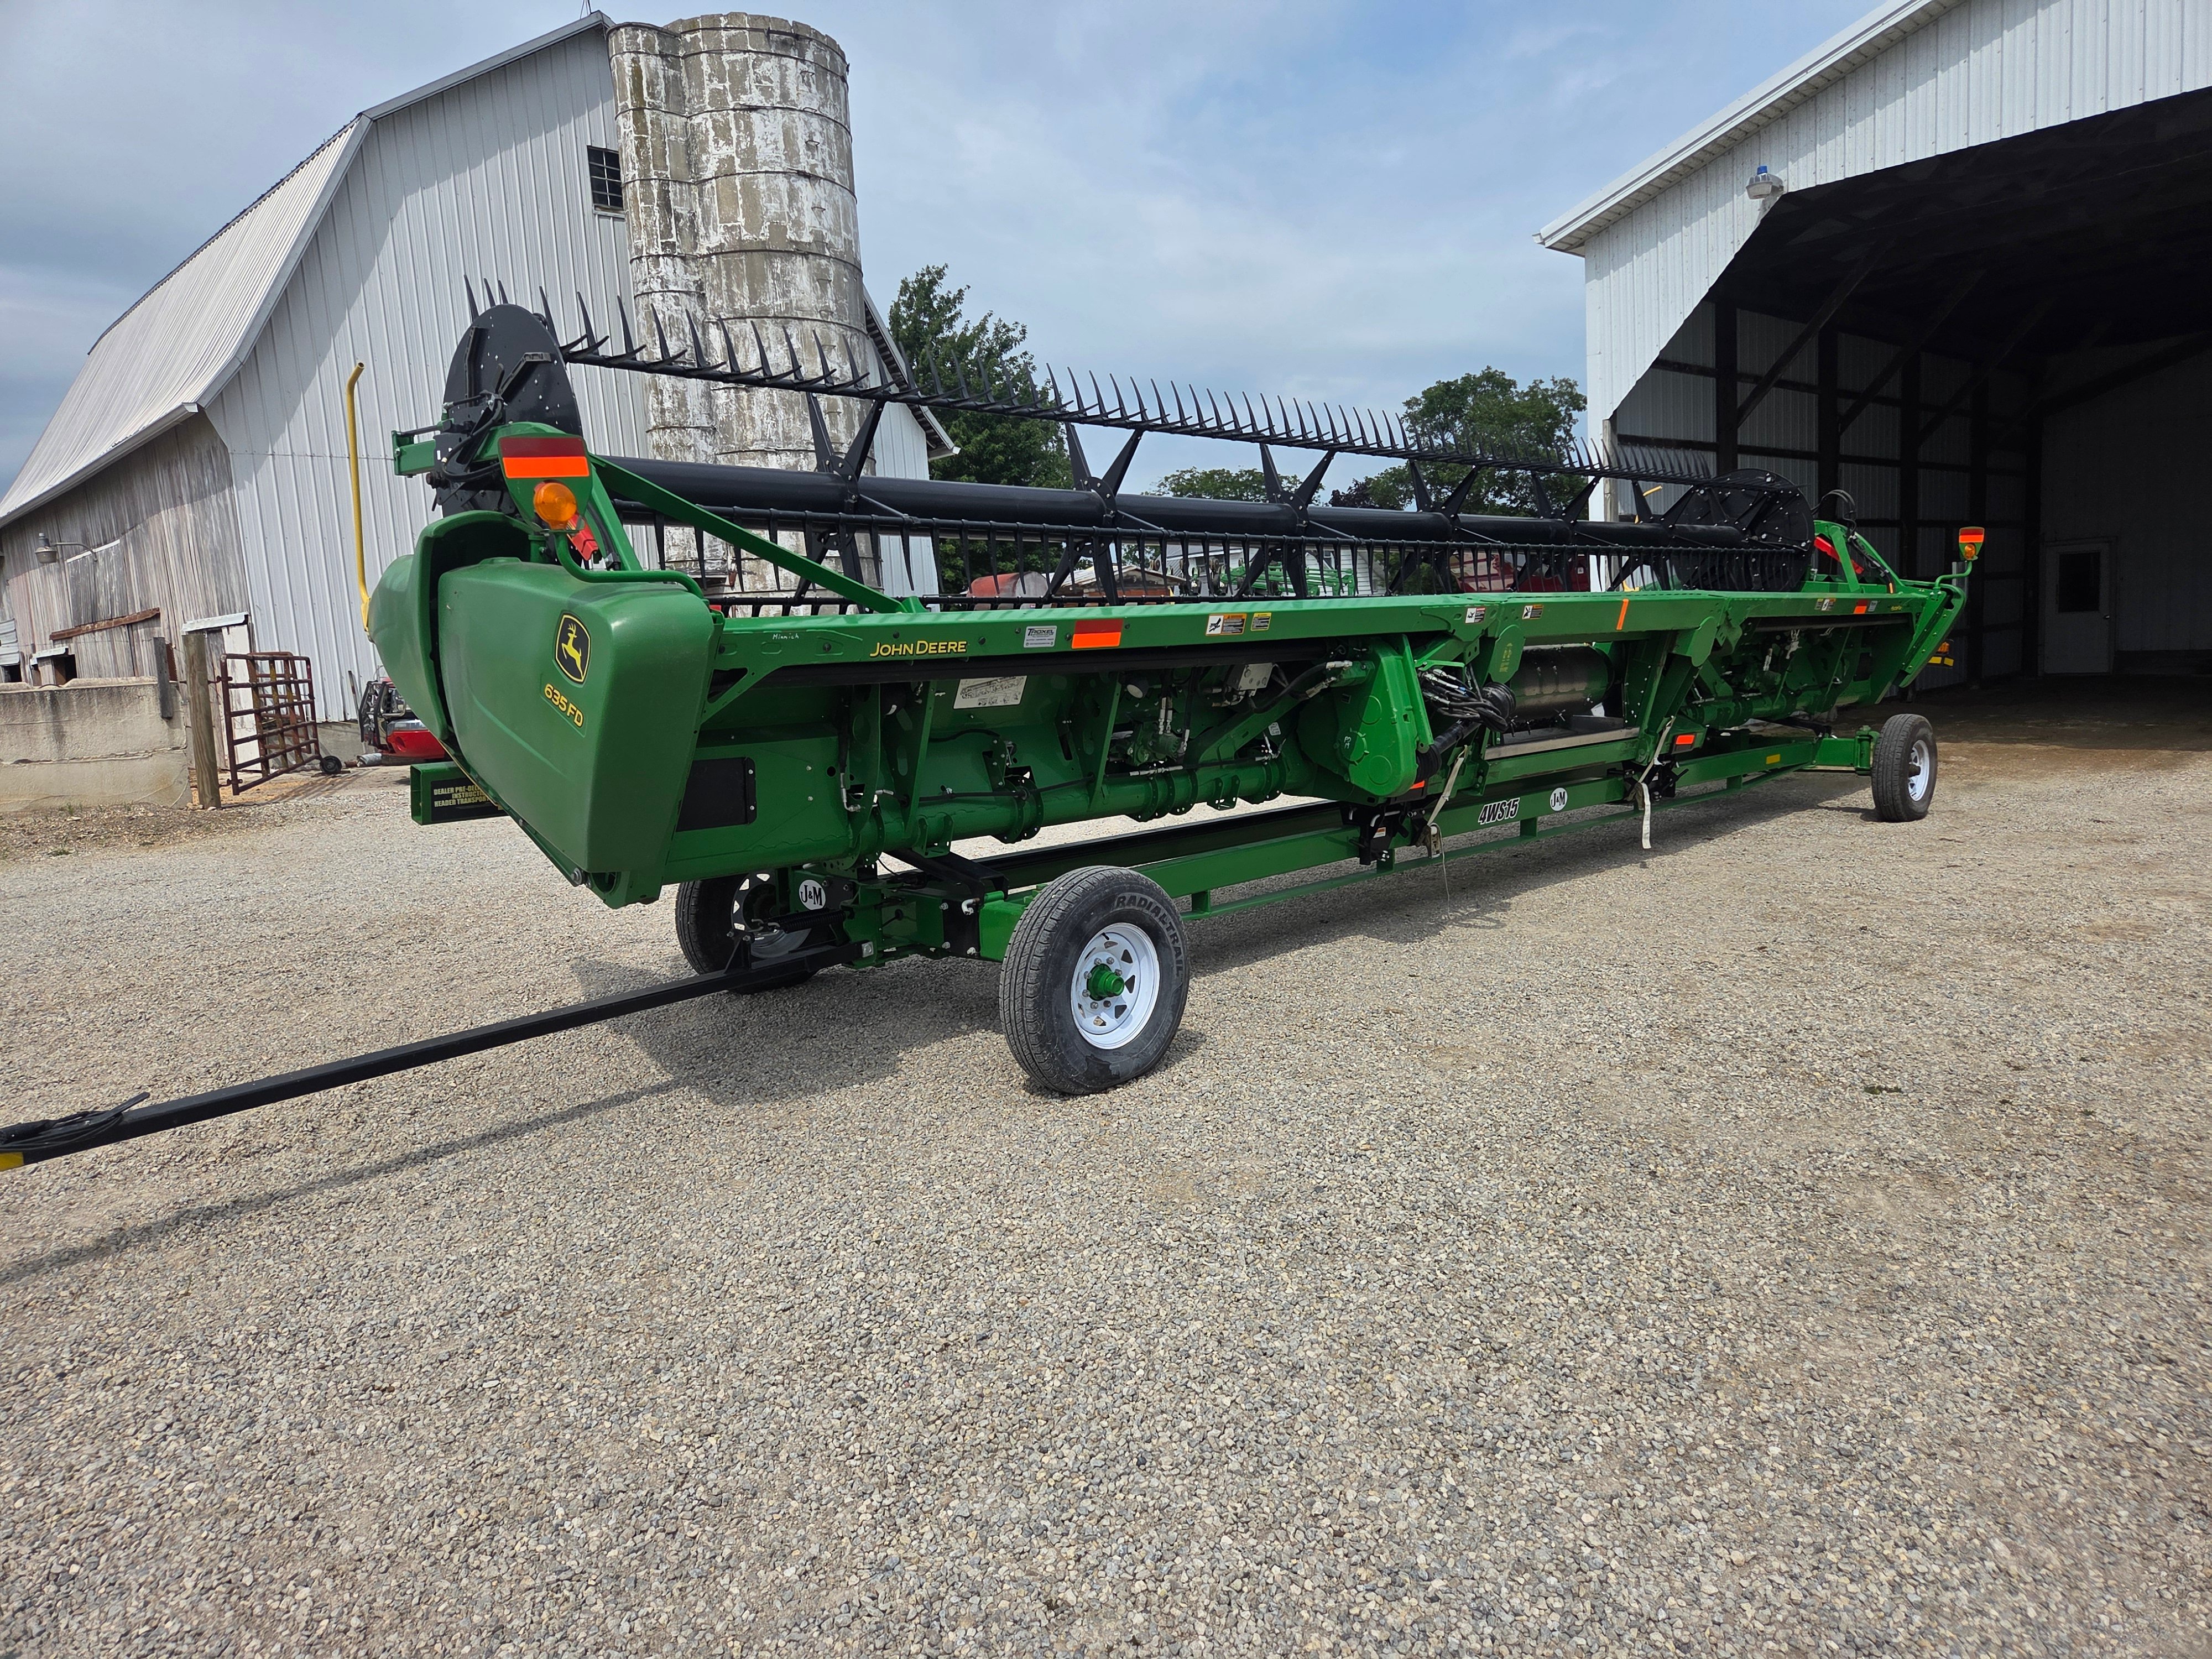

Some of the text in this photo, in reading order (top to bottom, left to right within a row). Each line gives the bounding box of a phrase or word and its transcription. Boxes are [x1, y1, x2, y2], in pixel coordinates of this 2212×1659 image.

[870, 640, 967, 656] JOHN DEERE
[434, 787, 454, 795] DEALER
[1551, 791, 1566, 808] J&M
[1478, 797, 1520, 825] 4WS15
[800, 885, 823, 906] J&M
[1115, 895, 1183, 977] RADIAL TRAIL
